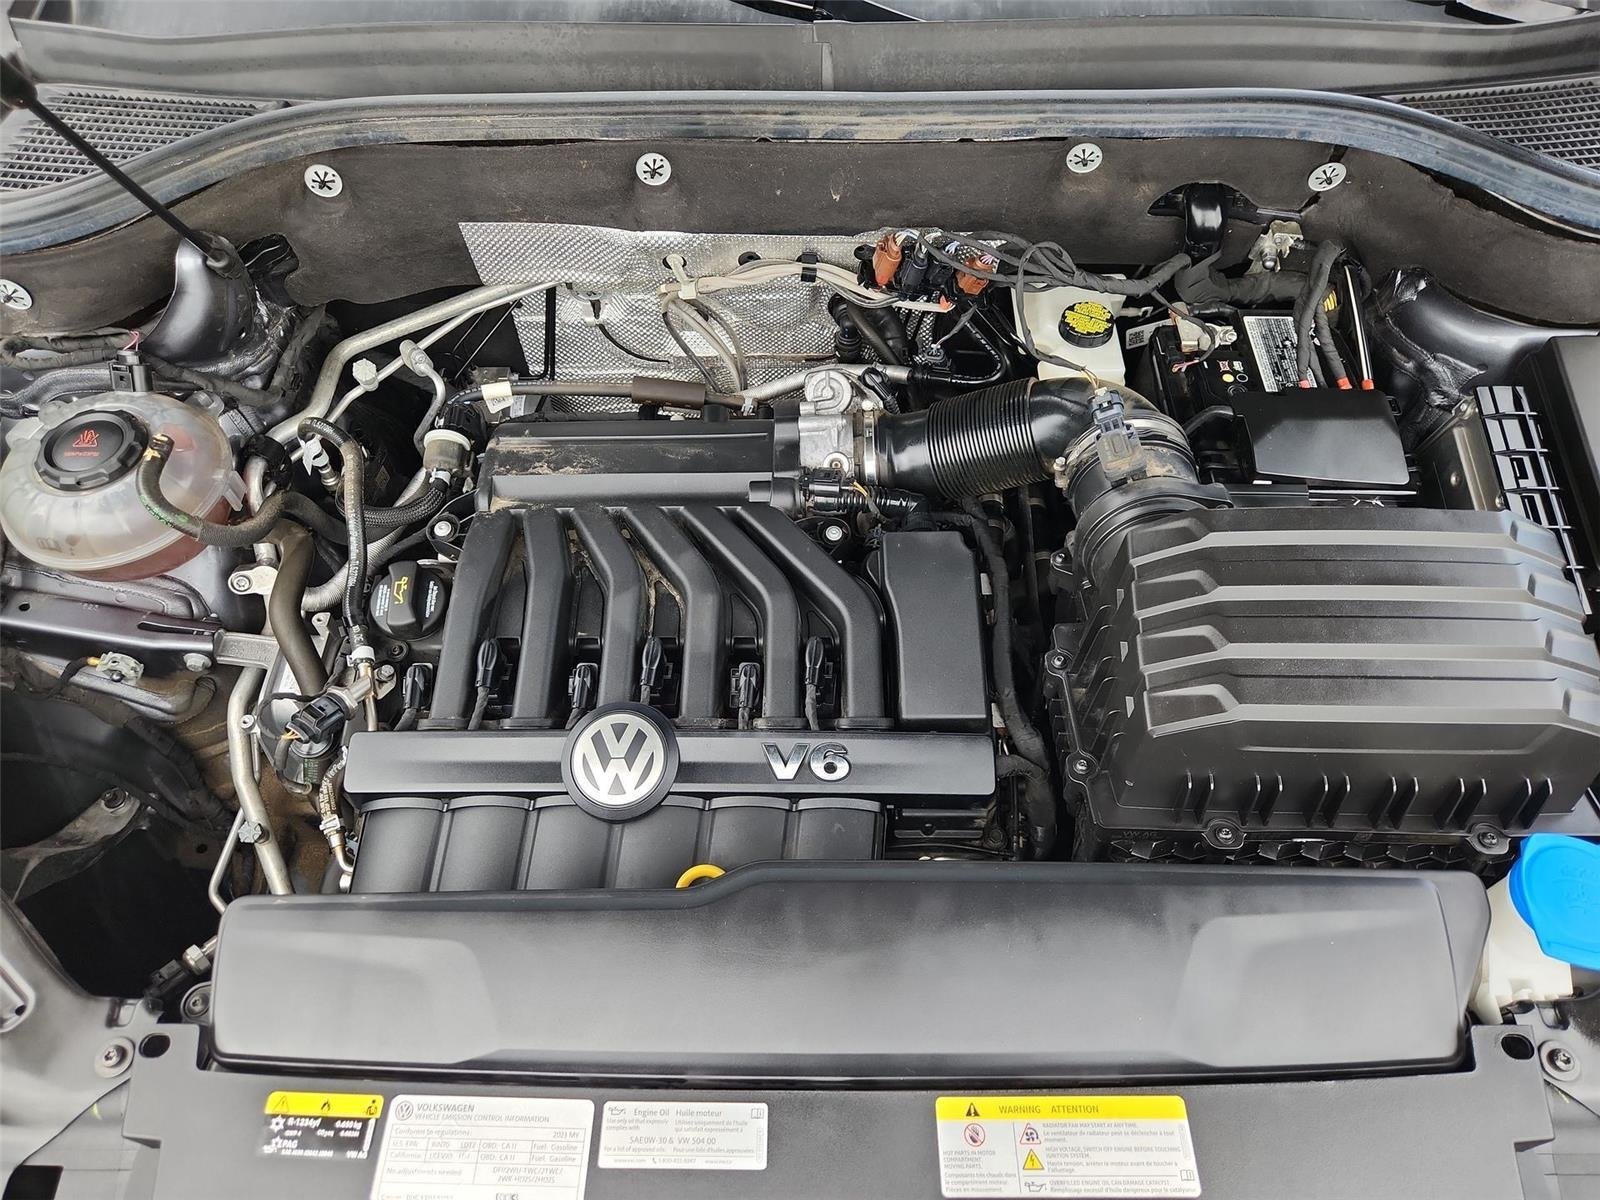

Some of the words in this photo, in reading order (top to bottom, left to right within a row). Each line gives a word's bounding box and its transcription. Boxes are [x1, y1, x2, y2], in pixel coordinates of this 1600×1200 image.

[761, 742, 852, 782] V6
[417, 1103, 475, 1112] VOLKSWAGEN
[998, 1105, 1041, 1114] WARNING
[1051, 1105, 1099, 1114] ATTENTION
[634, 1109, 658, 1118] Engine
[659, 1108, 670, 1116] Oil
[676, 1109, 695, 1117] Huile
[696, 1109, 722, 1117] moteur
[677, 1137, 690, 1145] VW
[692, 1137, 705, 1145] 504
[706, 1137, 717, 1145] 00
